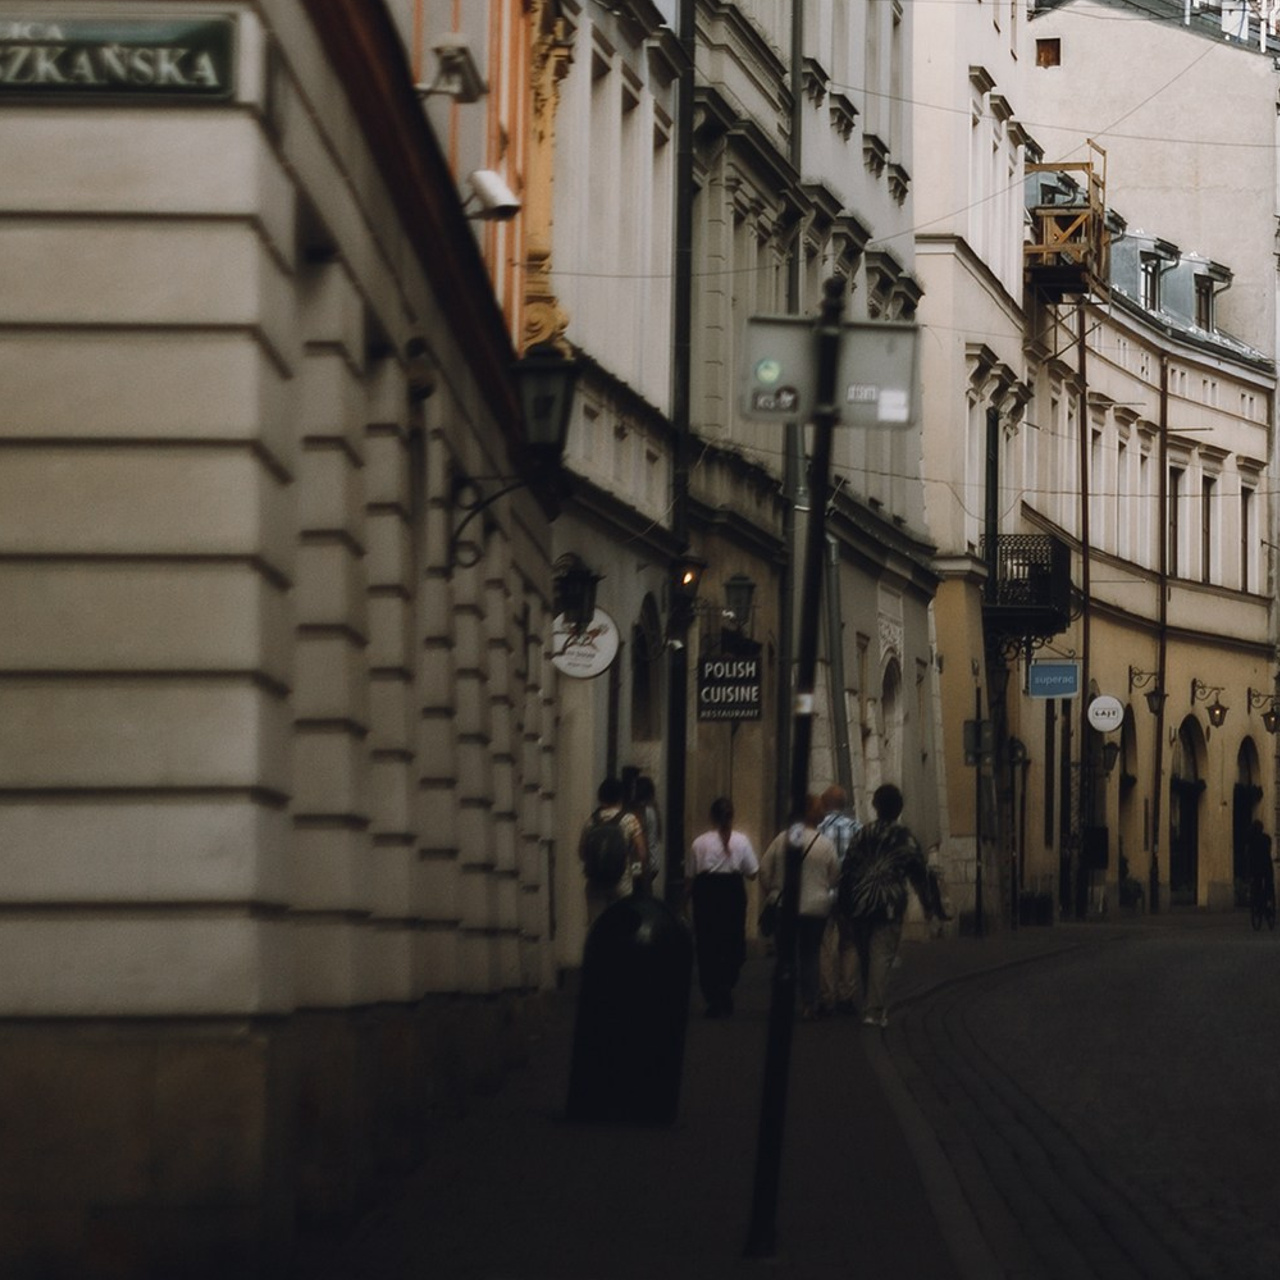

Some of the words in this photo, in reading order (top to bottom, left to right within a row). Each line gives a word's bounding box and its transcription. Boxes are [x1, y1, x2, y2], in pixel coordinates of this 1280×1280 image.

[0, 22, 65, 40] ICA
[0, 43, 219, 87] ZKAŃSKA
[704, 661, 757, 678] POLISH
[700, 685, 760, 703] CUISINE
[700, 709, 760, 718] RESTAURANT
